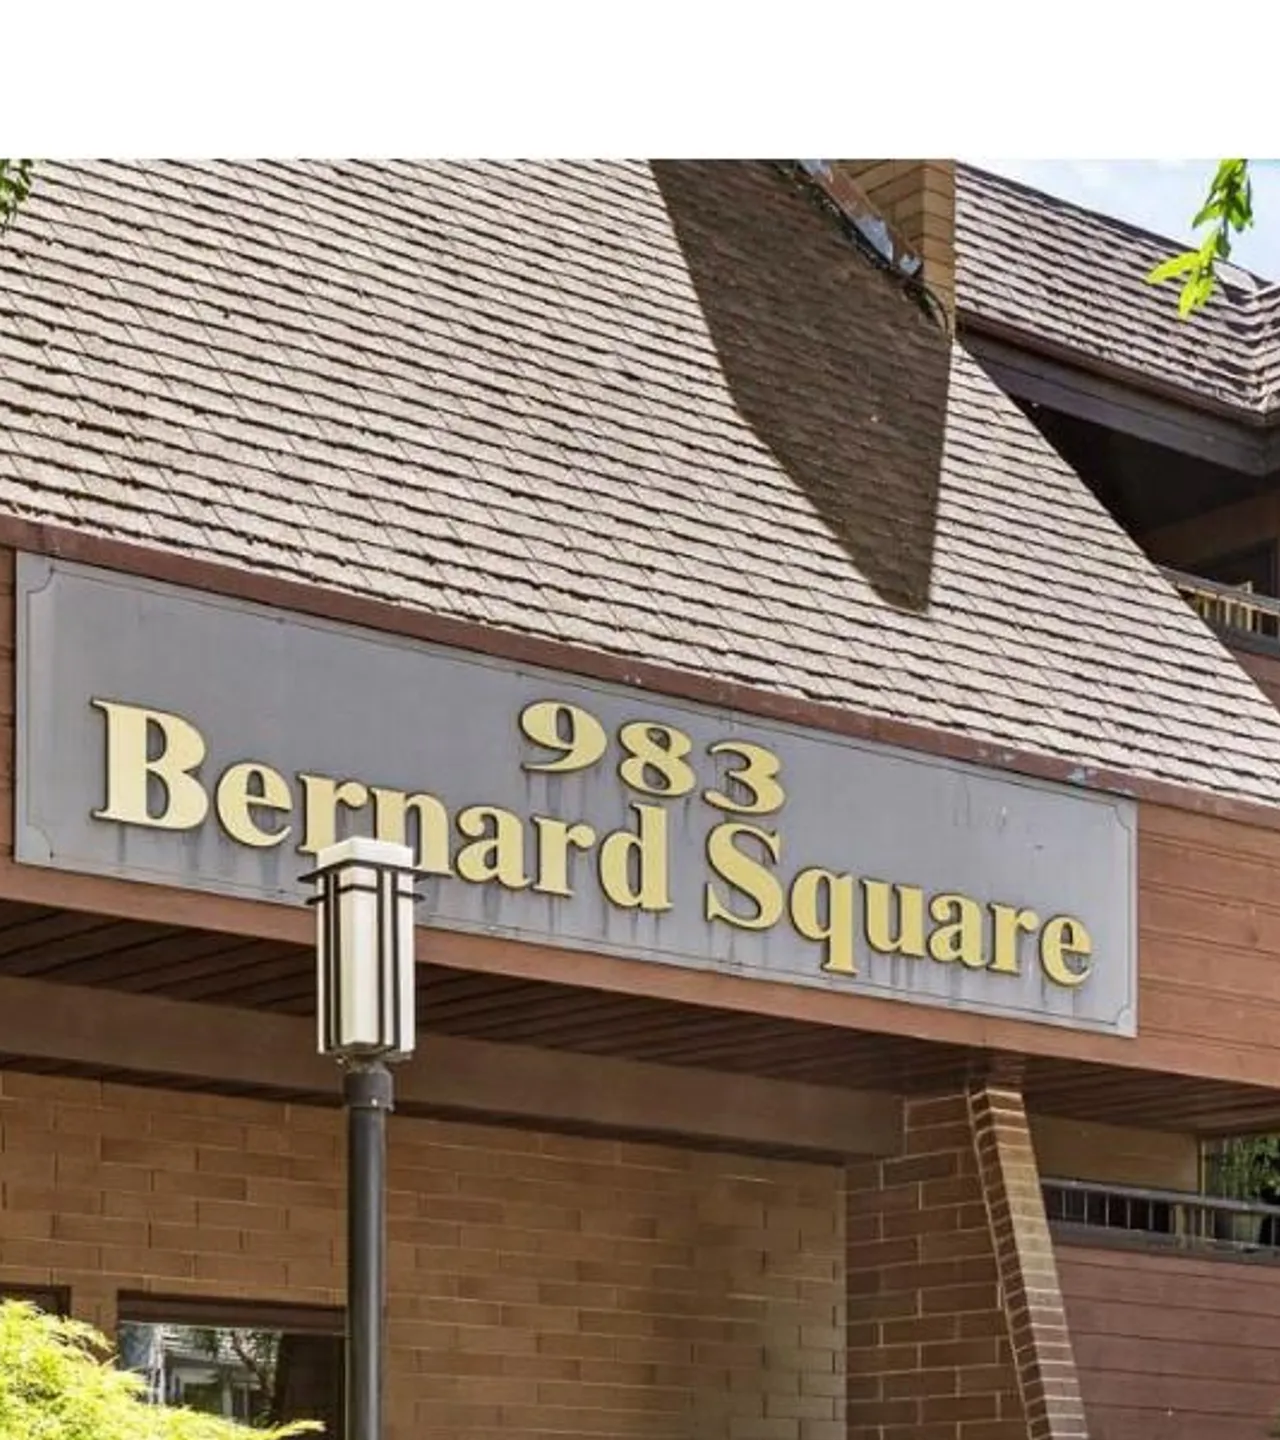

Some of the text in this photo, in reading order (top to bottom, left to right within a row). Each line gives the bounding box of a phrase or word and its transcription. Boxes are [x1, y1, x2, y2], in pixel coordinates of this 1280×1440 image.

[91, 698, 1094, 987] Bernard Square
[519, 699, 786, 816] 983
